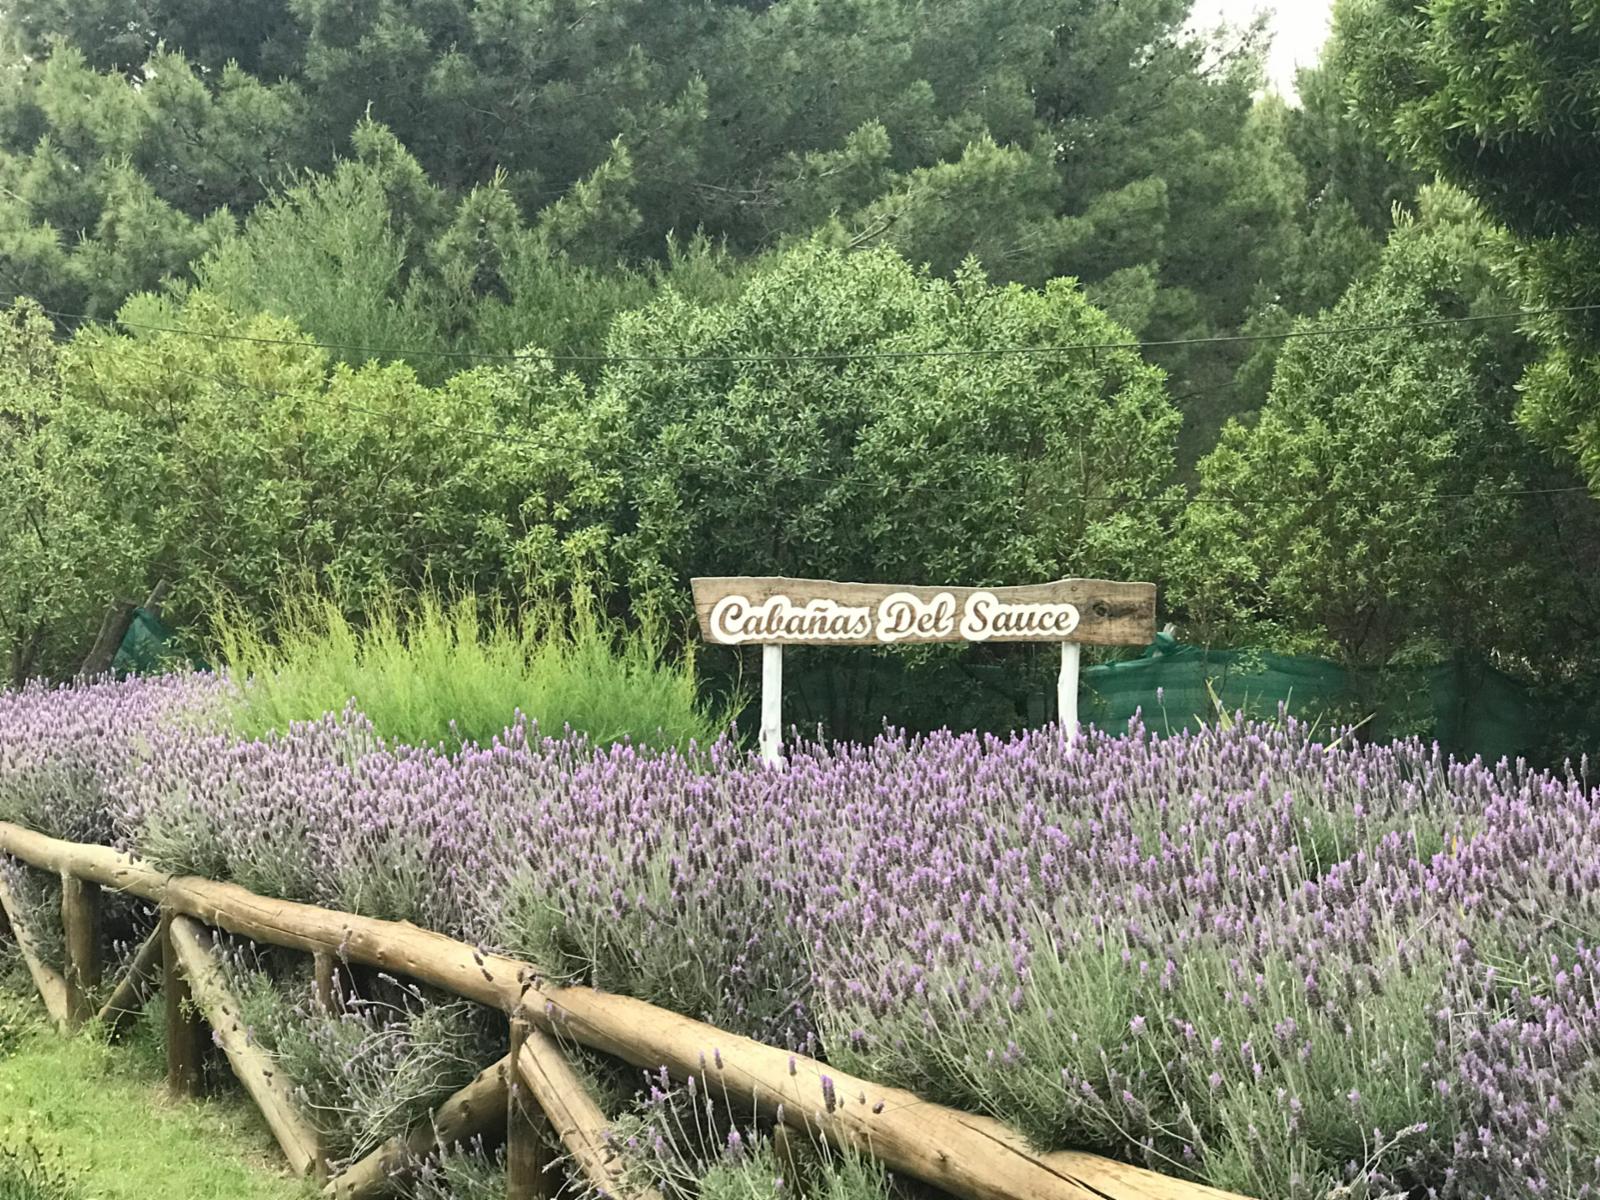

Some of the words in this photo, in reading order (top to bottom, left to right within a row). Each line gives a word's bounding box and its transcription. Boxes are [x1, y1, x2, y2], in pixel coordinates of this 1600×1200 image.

[717, 600, 869, 637] Cabañas
[882, 596, 952, 636] Del
[965, 596, 1073, 635] Sauce
